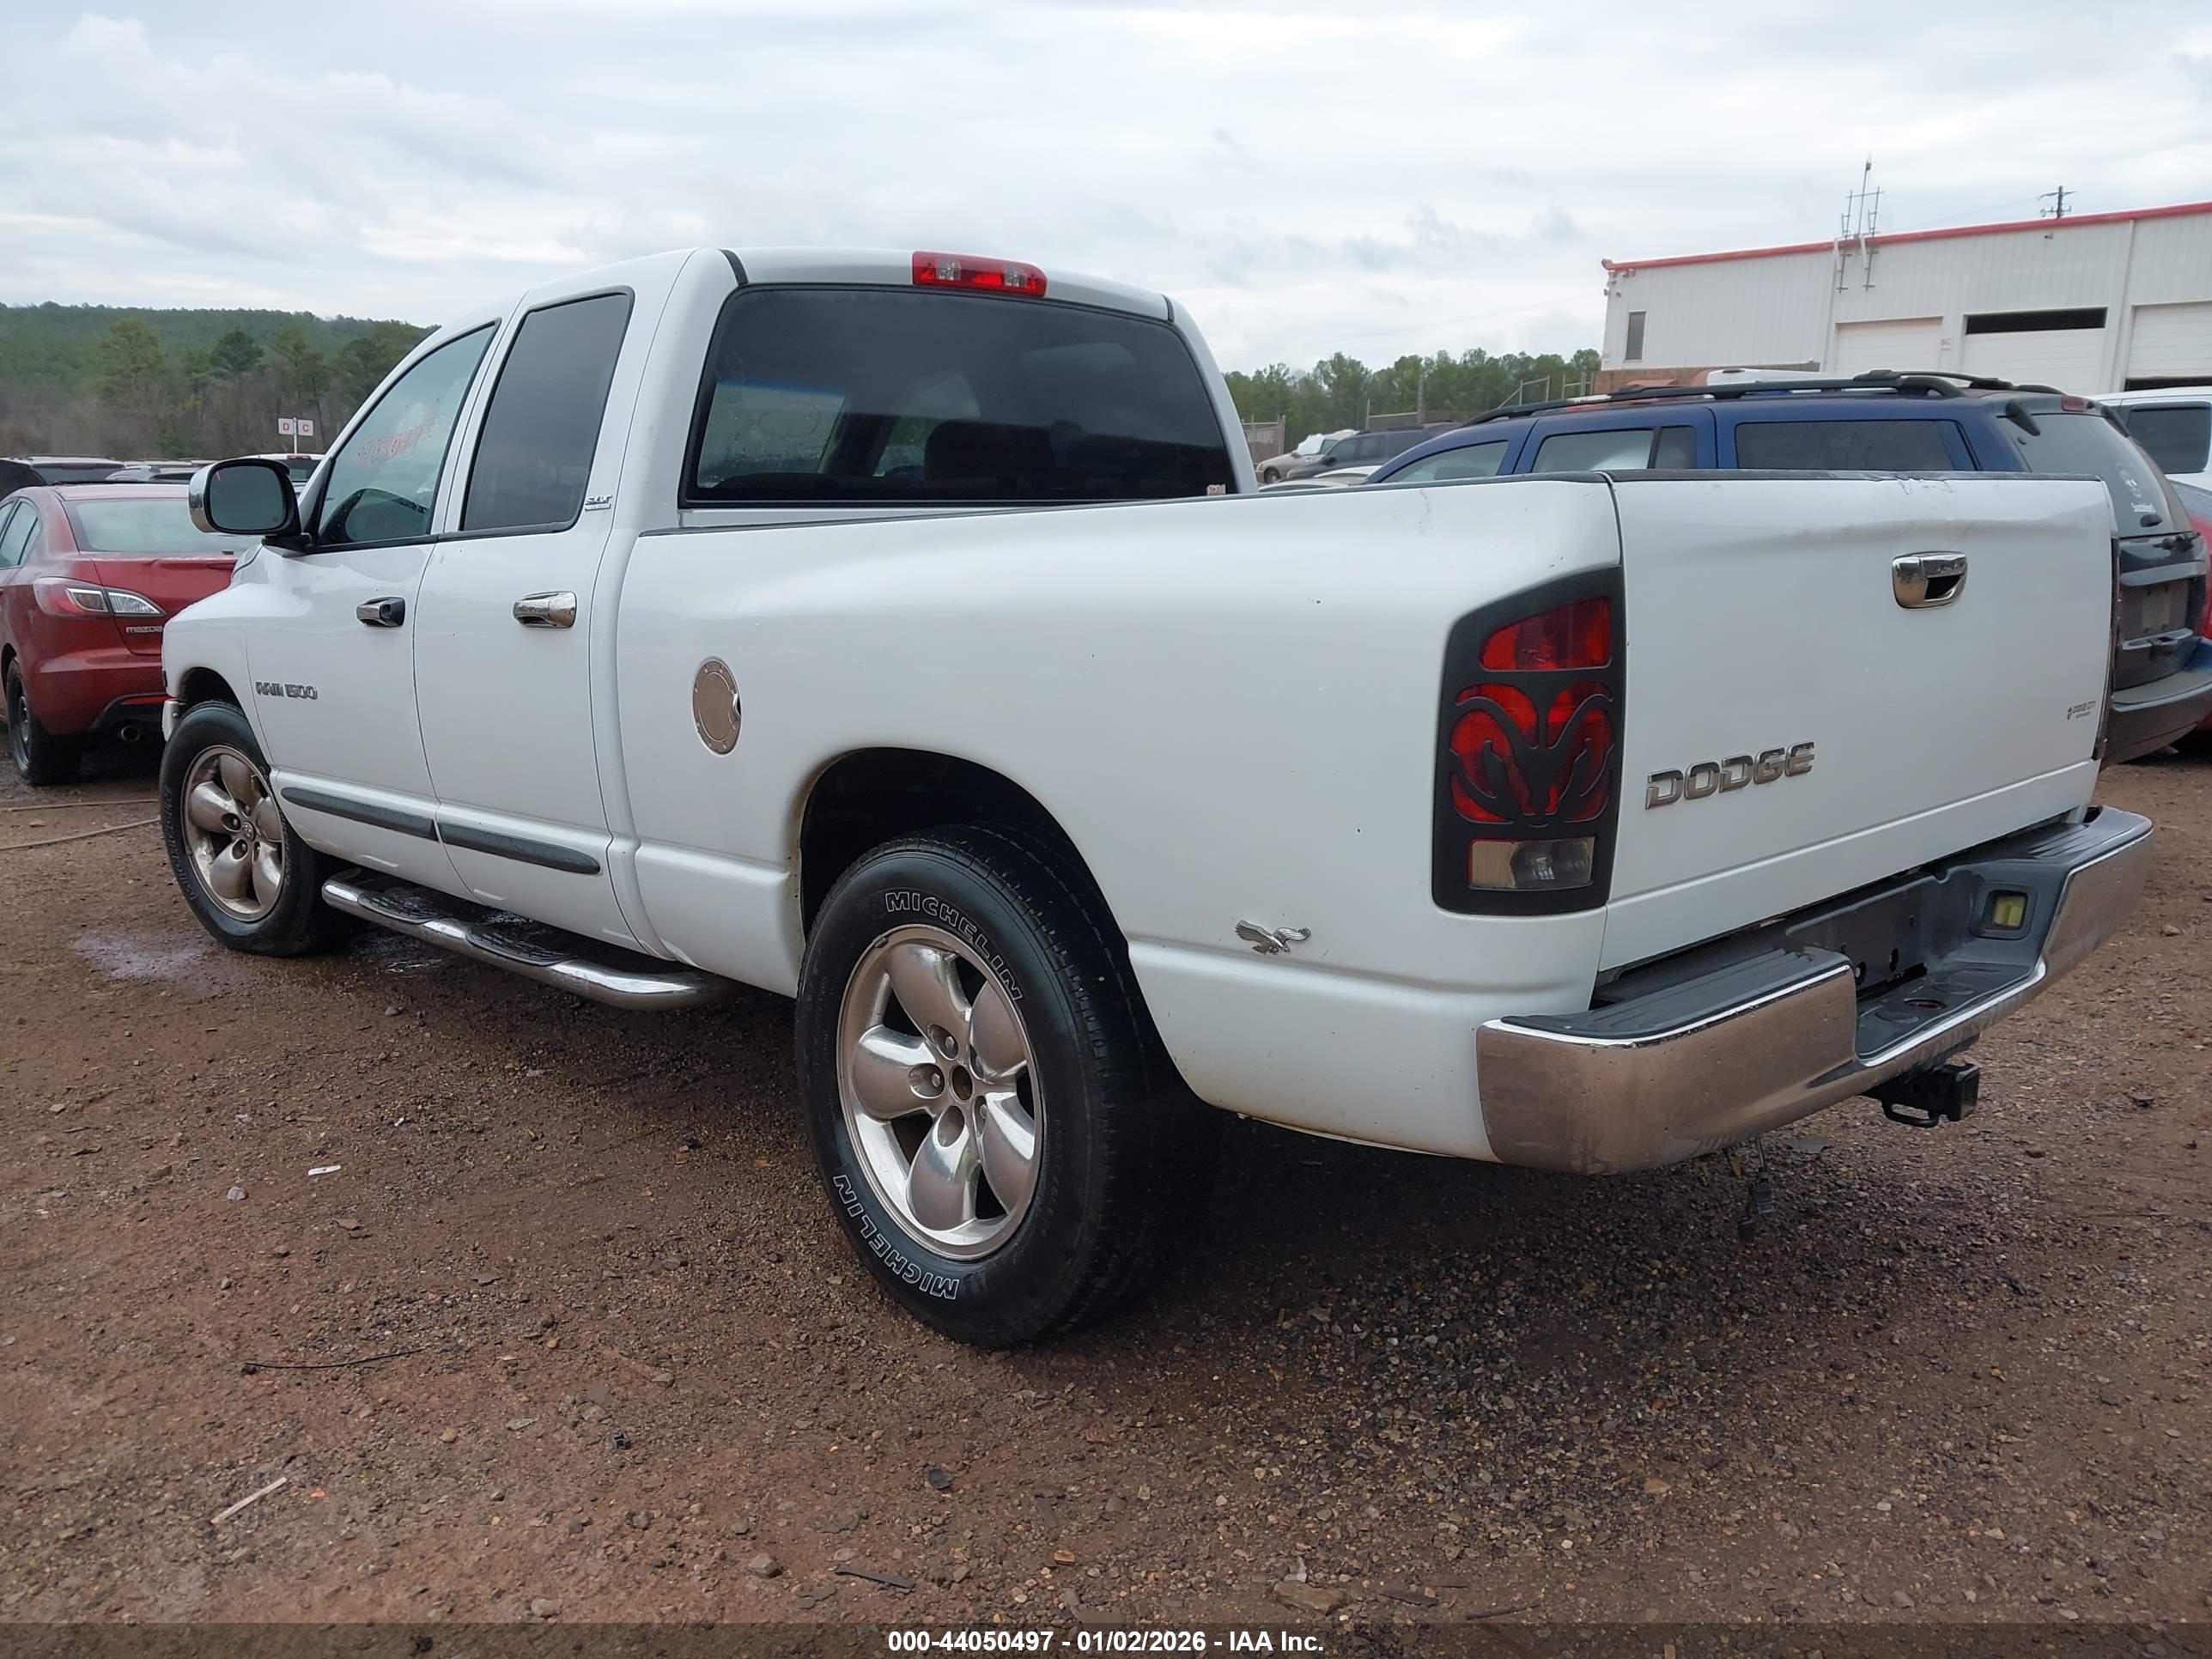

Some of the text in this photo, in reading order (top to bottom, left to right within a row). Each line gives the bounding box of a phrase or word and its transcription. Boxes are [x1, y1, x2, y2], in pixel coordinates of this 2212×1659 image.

[283, 422, 290, 431] D
[302, 423, 310, 433] C
[283, 684, 319, 700] 1500
[1645, 741, 1815, 811] DODGE
[884, 890, 1024, 1001] MICHELIN
[832, 1174, 960, 1300] MICHELIN
